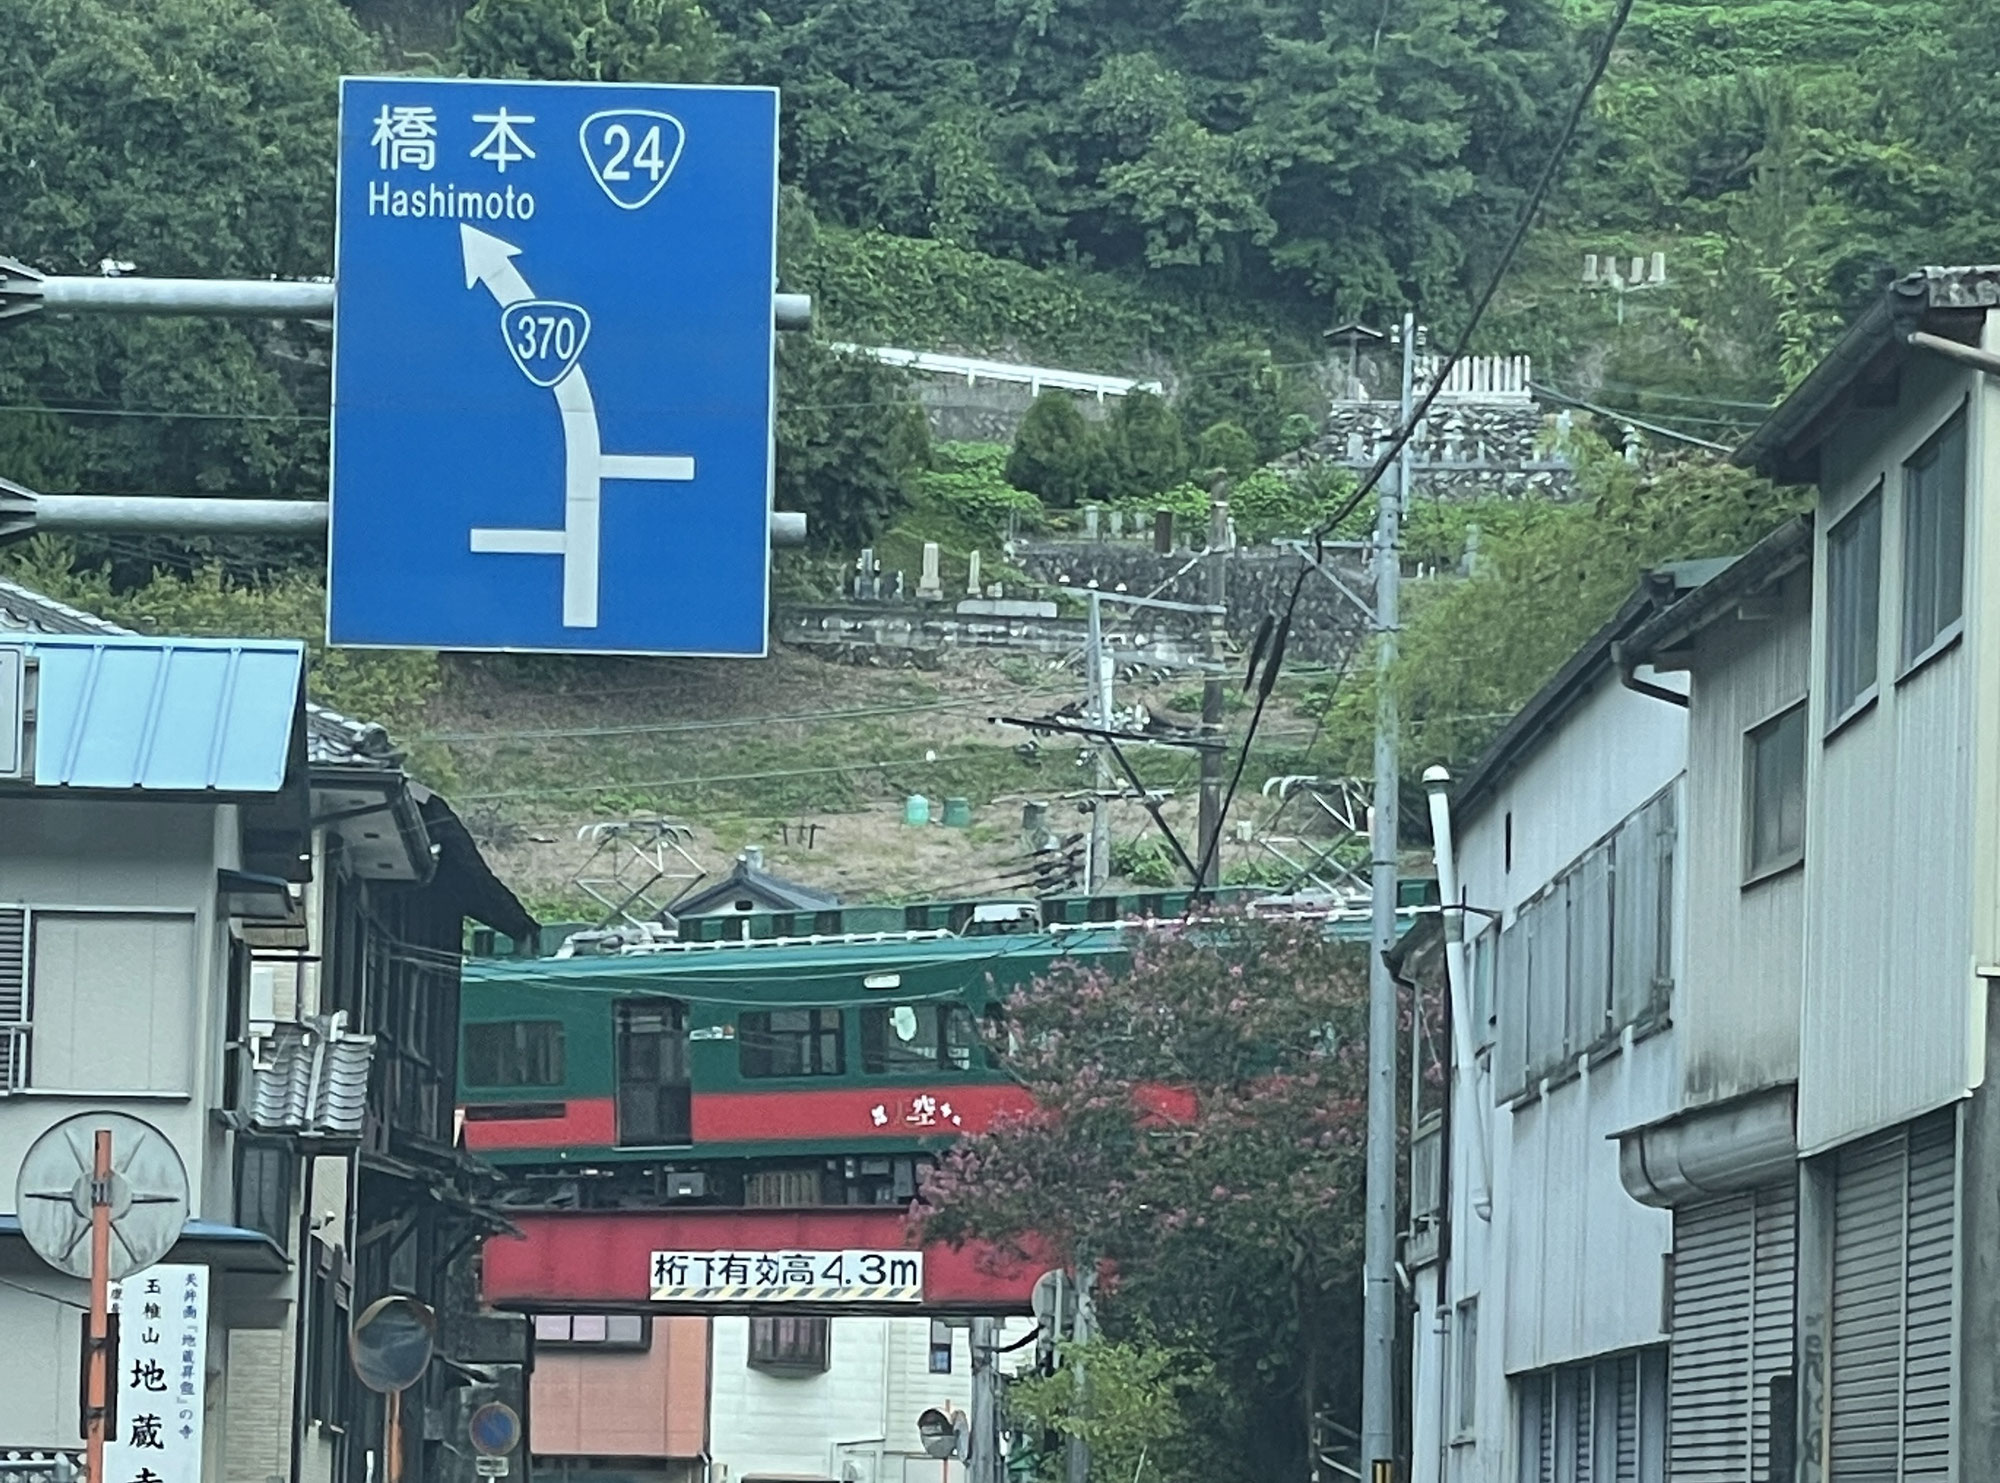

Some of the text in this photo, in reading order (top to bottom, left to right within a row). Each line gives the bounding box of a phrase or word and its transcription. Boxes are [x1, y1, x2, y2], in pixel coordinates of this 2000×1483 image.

[371, 105, 536, 173] 橋本
[602, 124, 664, 182] 24
[368, 180, 535, 220] Hashimoto
[517, 315, 576, 360] 370
